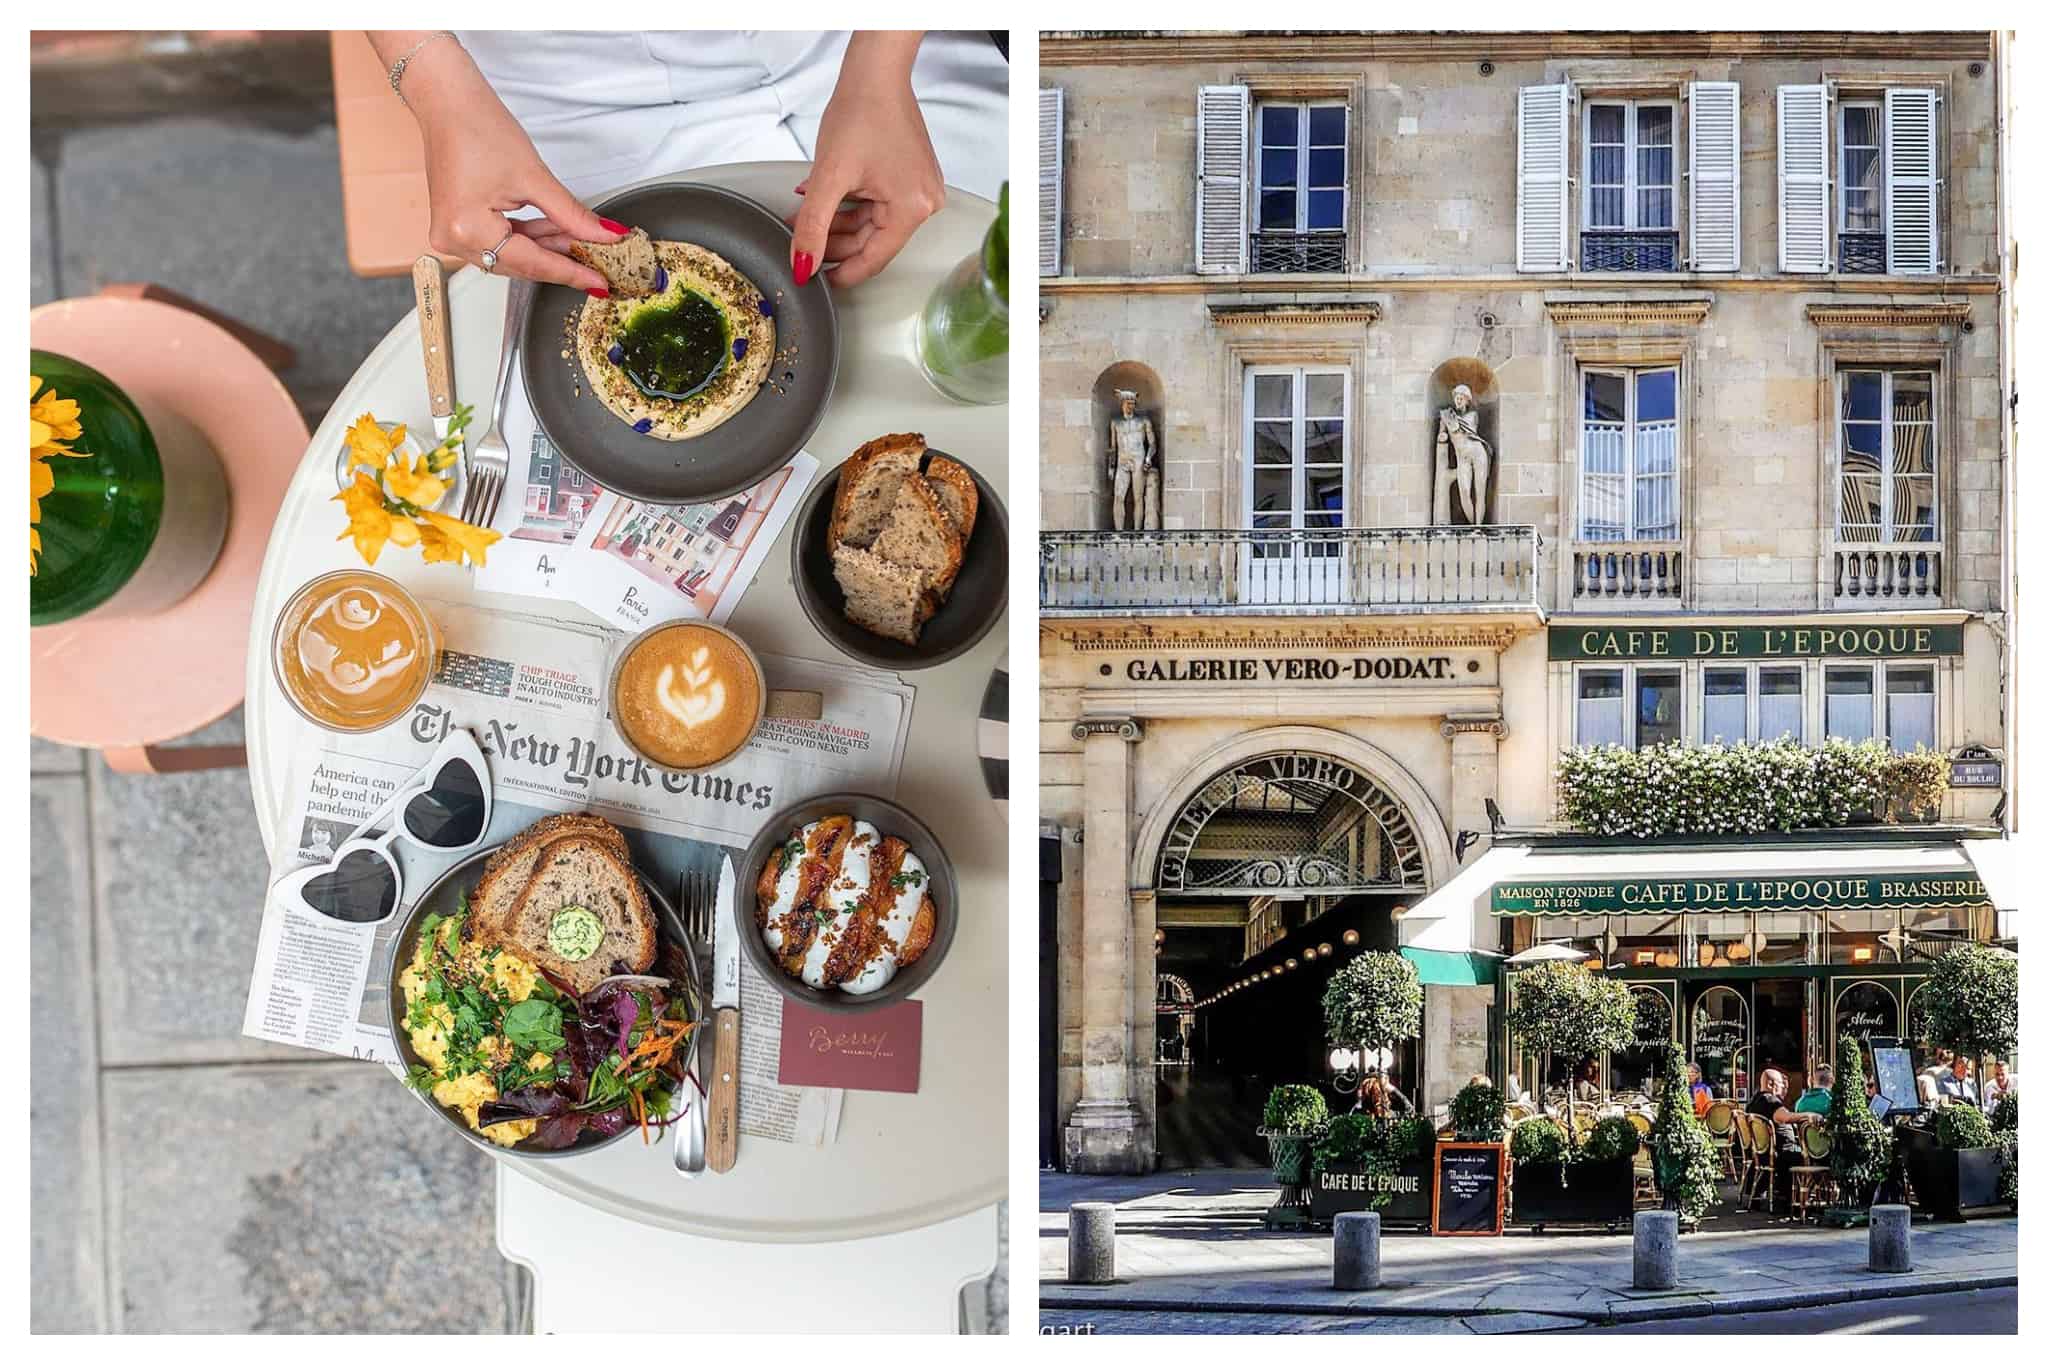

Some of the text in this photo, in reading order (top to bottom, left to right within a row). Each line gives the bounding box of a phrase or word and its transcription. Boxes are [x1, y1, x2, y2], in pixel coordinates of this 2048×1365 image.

[623, 586, 648, 616] Paris
[1581, 628, 1932, 656] CAFE DE L'EPOQUE
[520, 664, 577, 683] CHIP TRIAGE
[1126, 659, 1258, 681] GALERIE
[516, 682, 601, 706] IN AUTO INDUSTRY
[519, 673, 593, 696] TOUGH CHOICES
[776, 724, 816, 740] STAGING
[816, 731, 869, 750] NAVIGATES
[832, 725, 870, 740] MADRID
[481, 719, 560, 767] New
[564, 737, 652, 789] York
[816, 741, 849, 755] NEXUS
[313, 763, 395, 791] America can
[1268, 756, 1355, 790] VERO
[310, 778, 339, 799] help
[342, 789, 367, 802] end
[503, 776, 558, 794] INTERNATIONAL
[559, 788, 586, 800] EDITION
[1499, 887, 1615, 899] MAISON FONDEE
[1534, 898, 1580, 908] EN 1826
[1621, 884, 1687, 904] CAFE
[1694, 883, 1728, 902] DE
[1736, 880, 1869, 902] L'EPOQUE
[1351, 1174, 1365, 1191] DE
